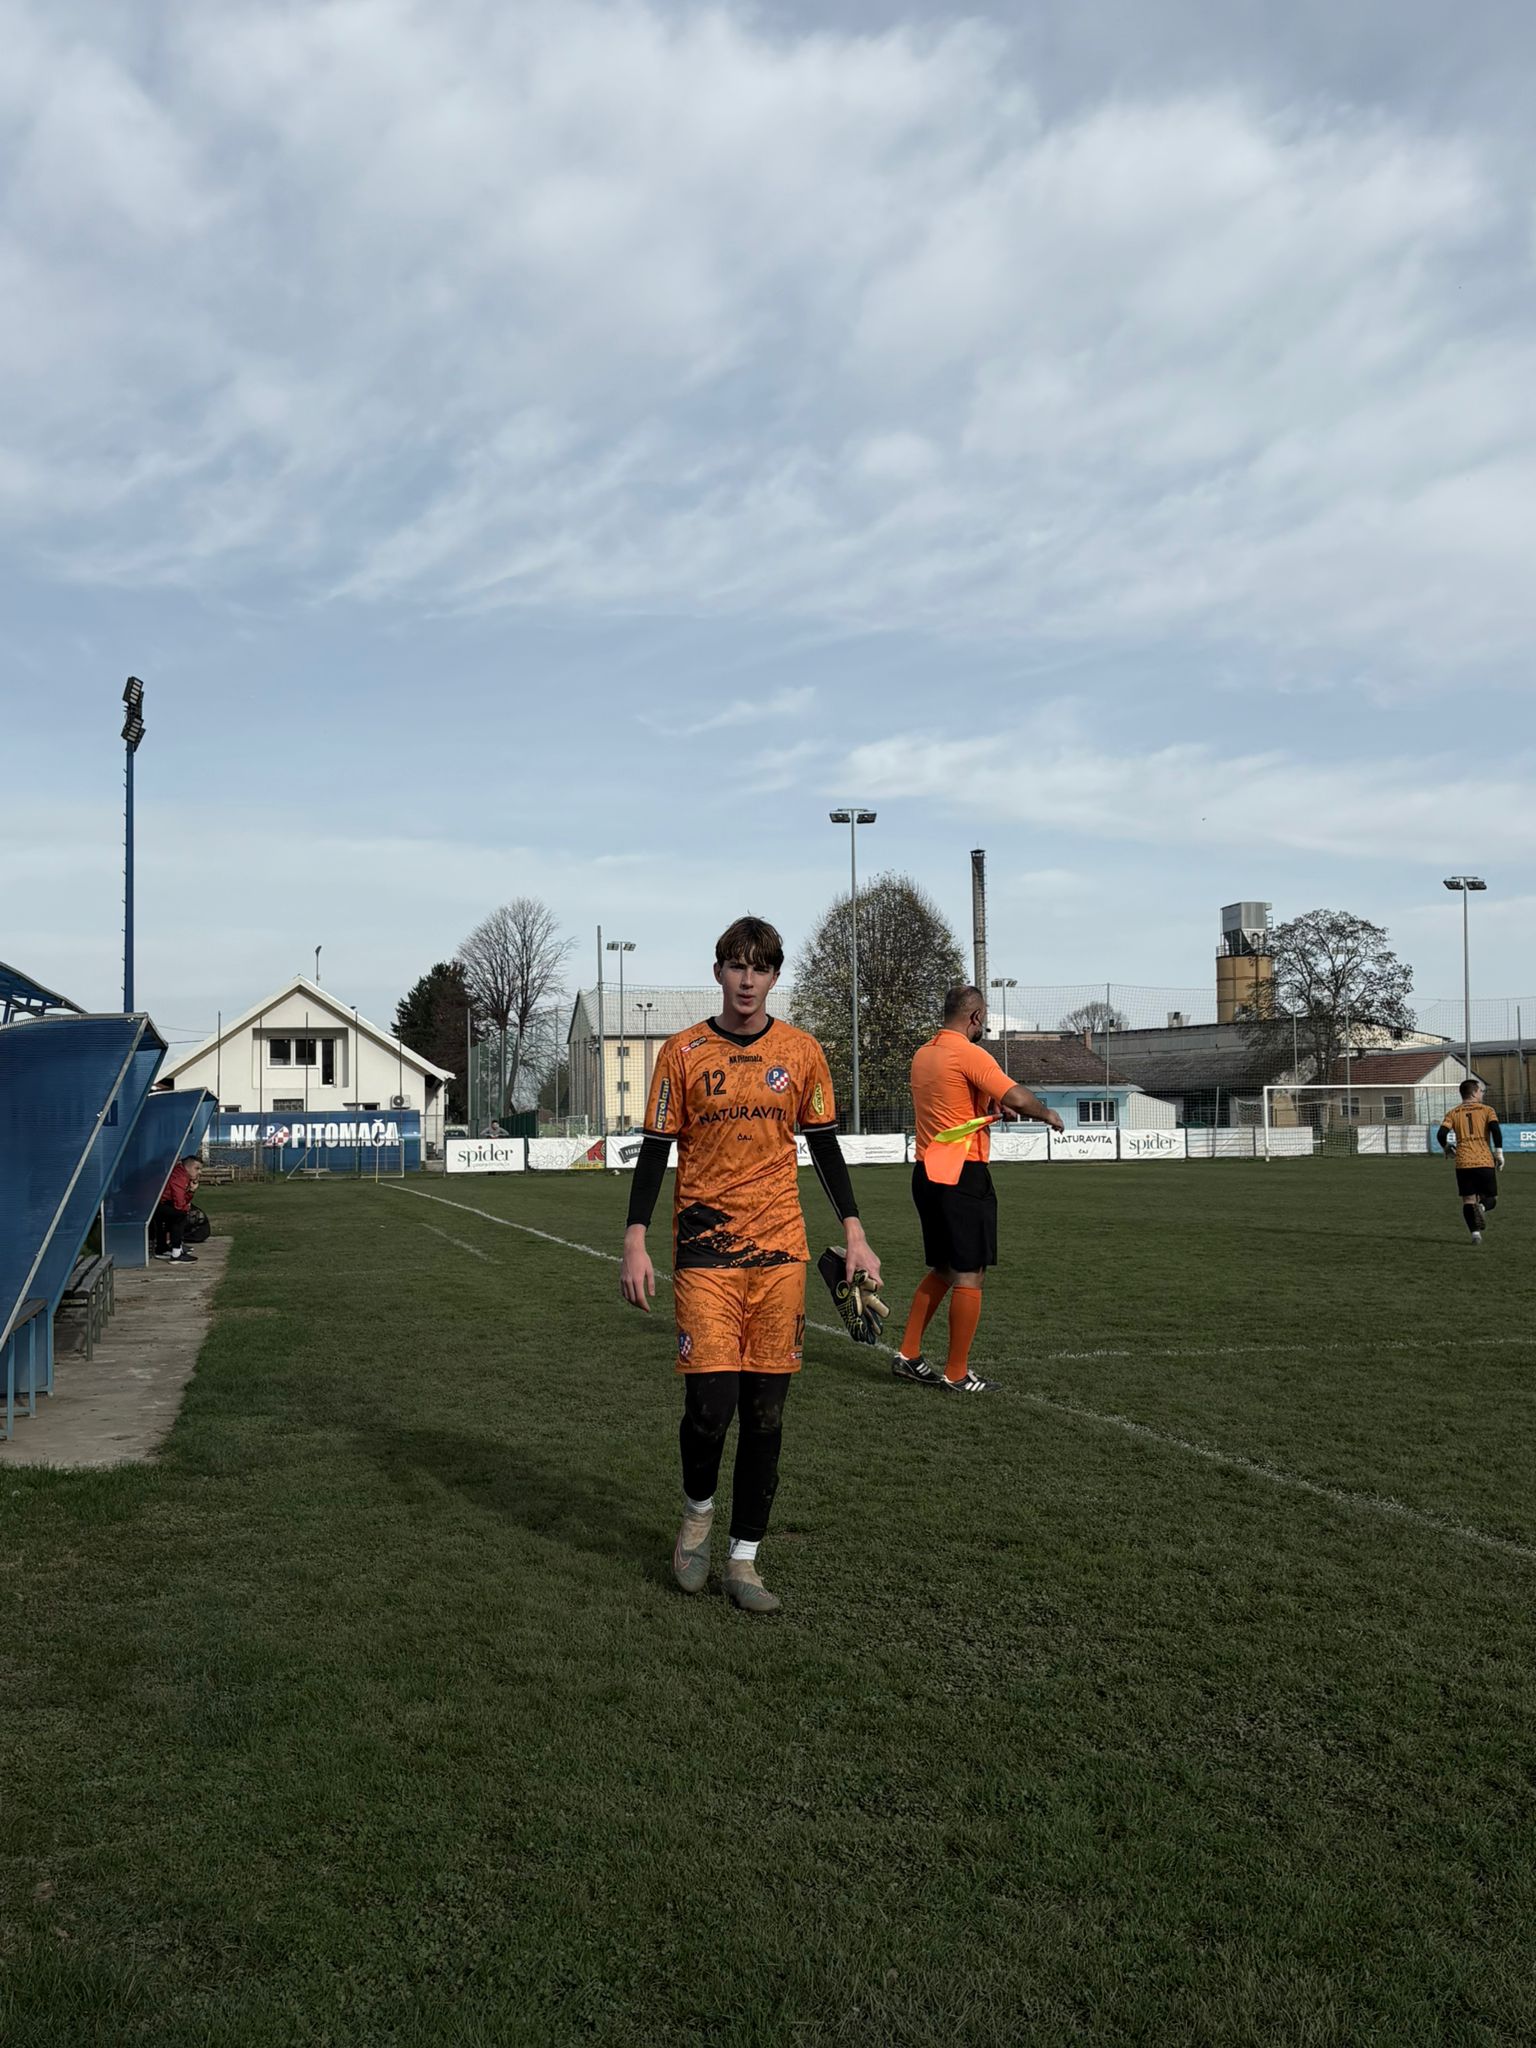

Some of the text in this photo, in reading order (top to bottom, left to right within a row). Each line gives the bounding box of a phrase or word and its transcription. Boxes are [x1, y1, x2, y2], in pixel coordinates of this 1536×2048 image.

[702, 1070, 726, 1097] 12
[656, 1078, 669, 1130] agroland
[231, 1119, 399, 1148] NK PITOMAČA
[1466, 1113, 1473, 1135] 1
[1054, 1134, 1112, 1145] NATURAVITA
[1129, 1133, 1176, 1154] spider
[457, 1143, 513, 1167] spider
